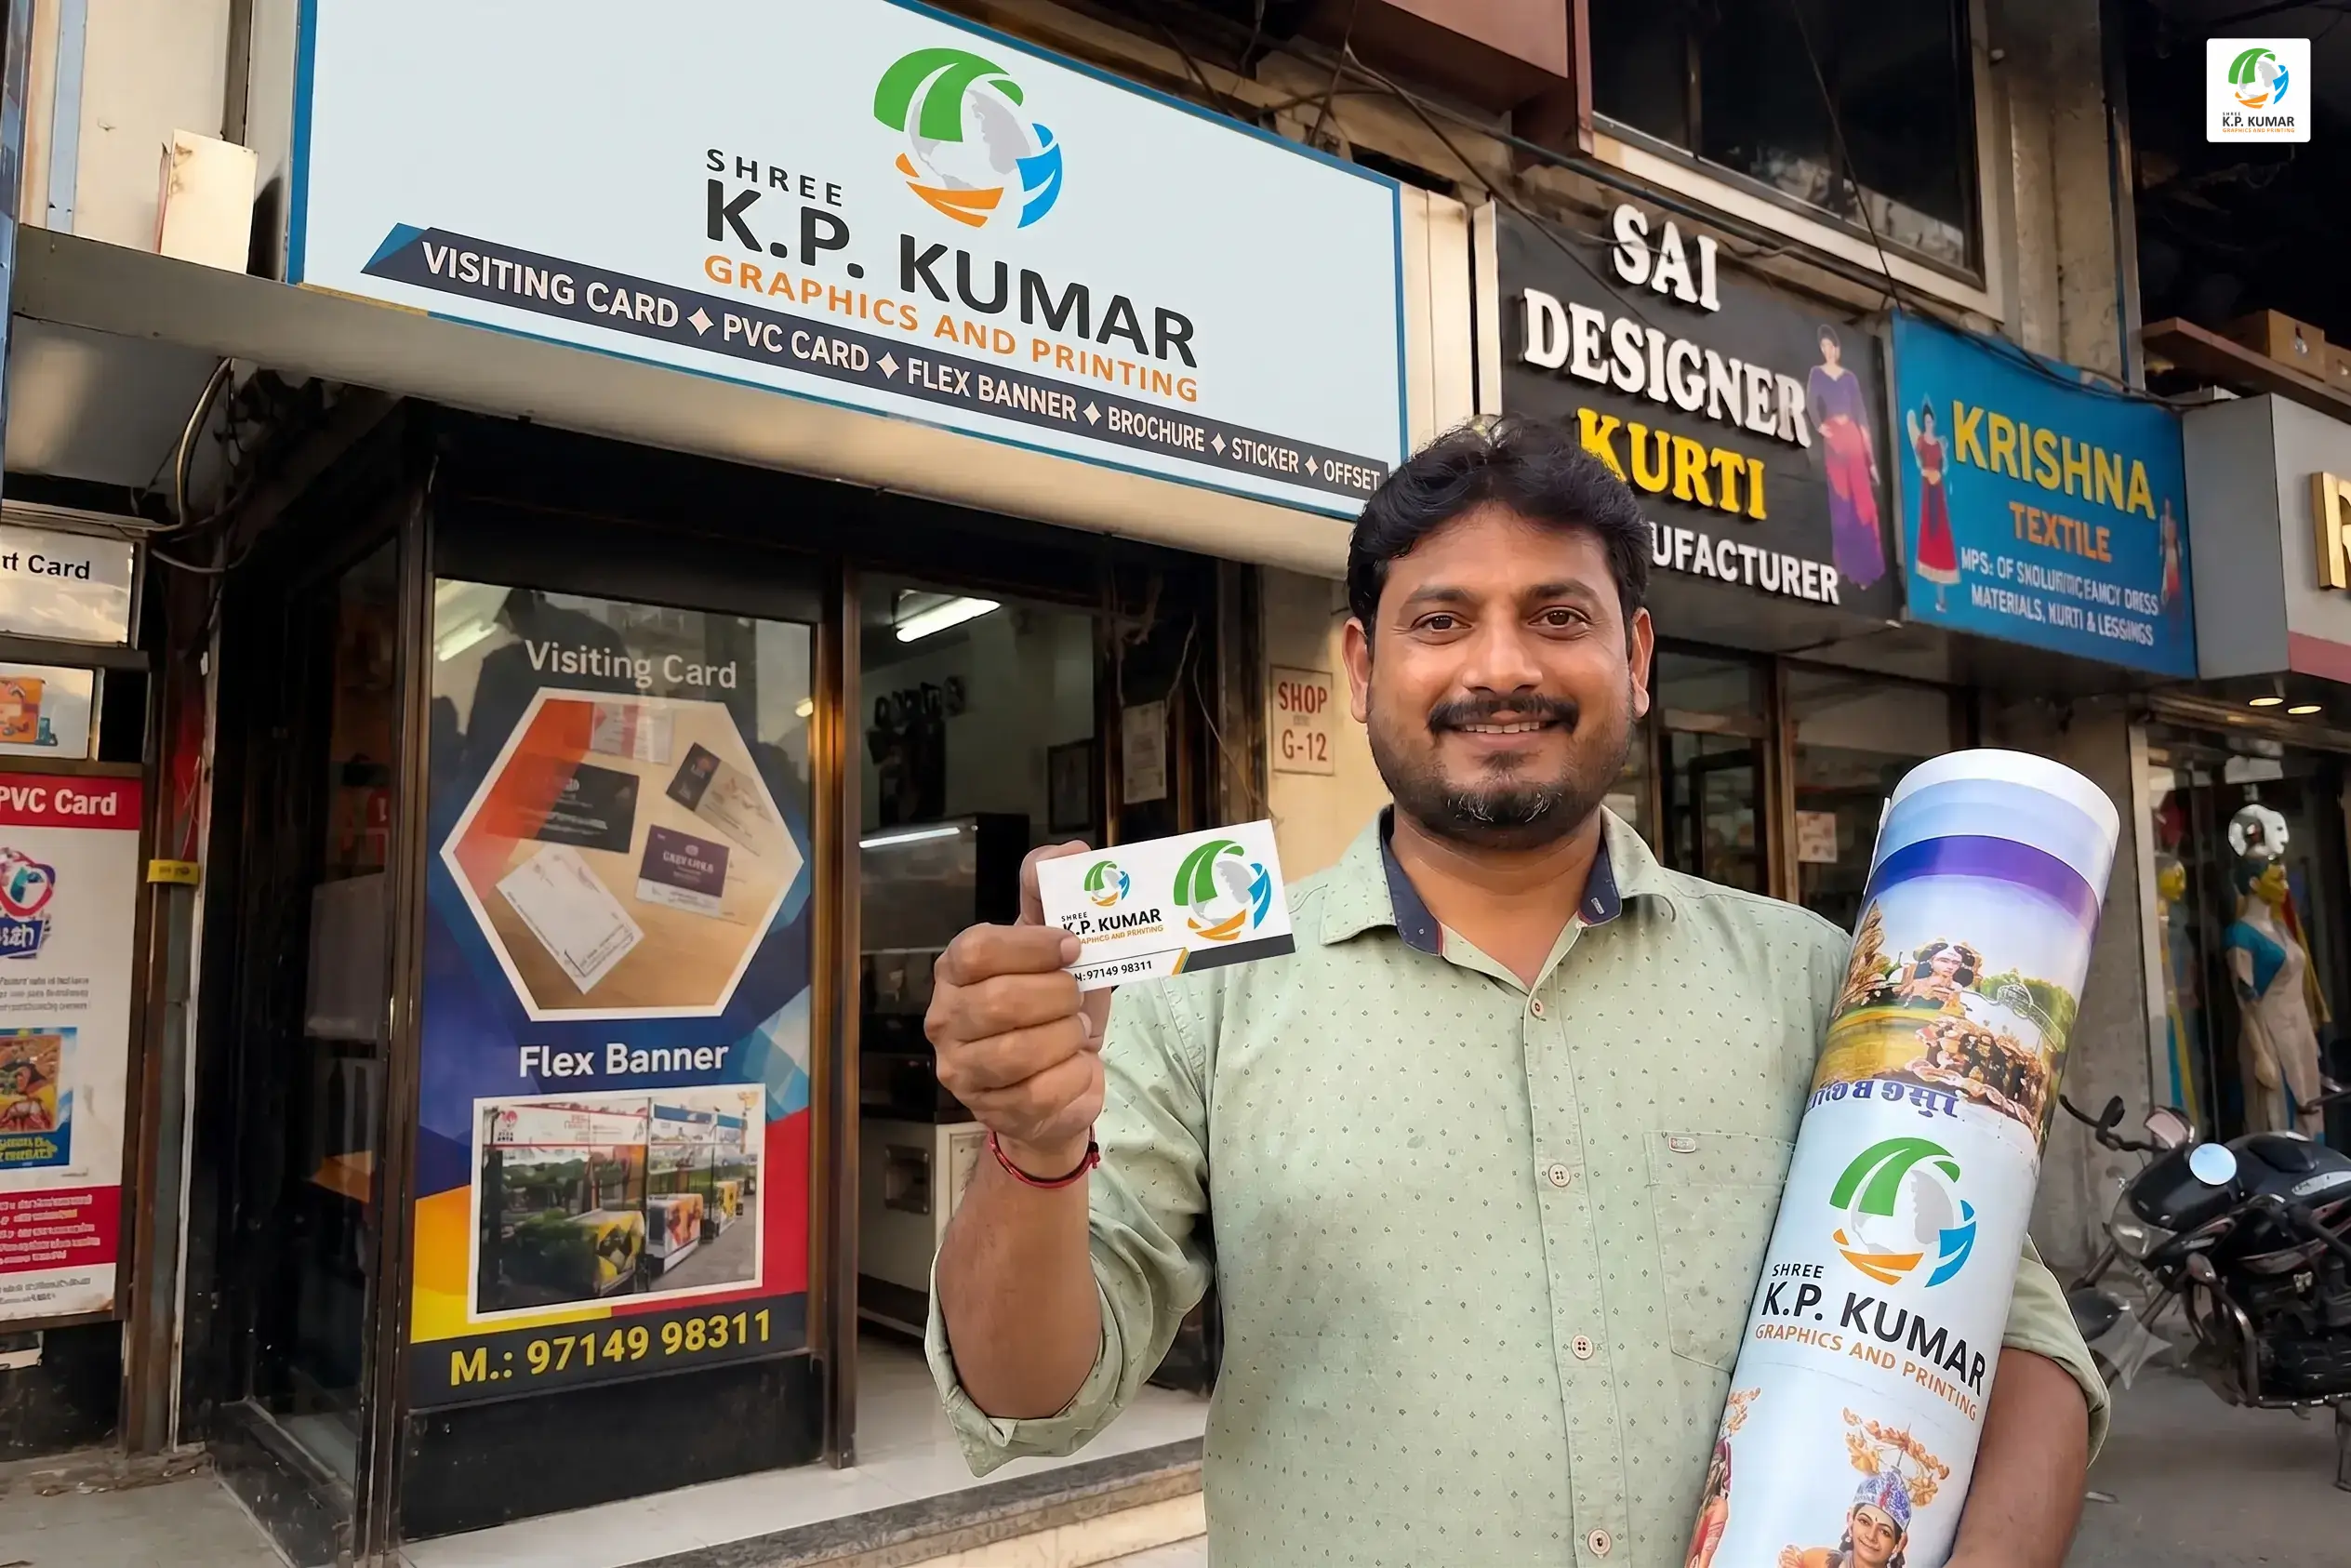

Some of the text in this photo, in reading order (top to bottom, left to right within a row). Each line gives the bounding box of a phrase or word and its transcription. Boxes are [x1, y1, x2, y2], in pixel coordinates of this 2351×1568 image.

[706, 149, 843, 206] SHREE
[706, 179, 1198, 368] K.P. KUMAR
[1613, 203, 1721, 312] SAI
[704, 254, 1199, 403] GRAPHICS AND PRINTING
[421, 241, 1381, 491] VISITING CARD PVC CARD FLEX BANNER BROCHURE STICKER OFFSET
[1523, 287, 1812, 448] DESIGNER
[1577, 407, 1767, 521] KURTI
[1953, 400, 2157, 520] KRISHNA
[2009, 500, 2113, 563] TEXTILE
[28, 554, 90, 579] Card
[1649, 521, 1840, 605] UFACTURER
[1997, 556, 2013, 579] OF
[2124, 588, 2158, 617] DRESS
[1972, 583, 2046, 624] MATERIALS,
[2086, 612, 2096, 632] &
[525, 640, 737, 689] Visiting Card
[1278, 681, 1328, 714] SHOP
[1282, 728, 1328, 762] G-12
[0, 786, 117, 816] PVC Card
[1061, 911, 1088, 923] SHREE
[1099, 908, 1162, 932] KUMAR
[1087, 966, 1119, 980] 97149
[1122, 961, 1152, 975] 98311
[519, 1043, 729, 1078] Flex Banner
[1772, 1263, 1824, 1279] SHREE
[450, 1308, 770, 1387] M.: 97149 98311
[1761, 1281, 1986, 1397] K.P. KUMAR
[1755, 1323, 1977, 1421] GRAPHICS AND PRINTING
